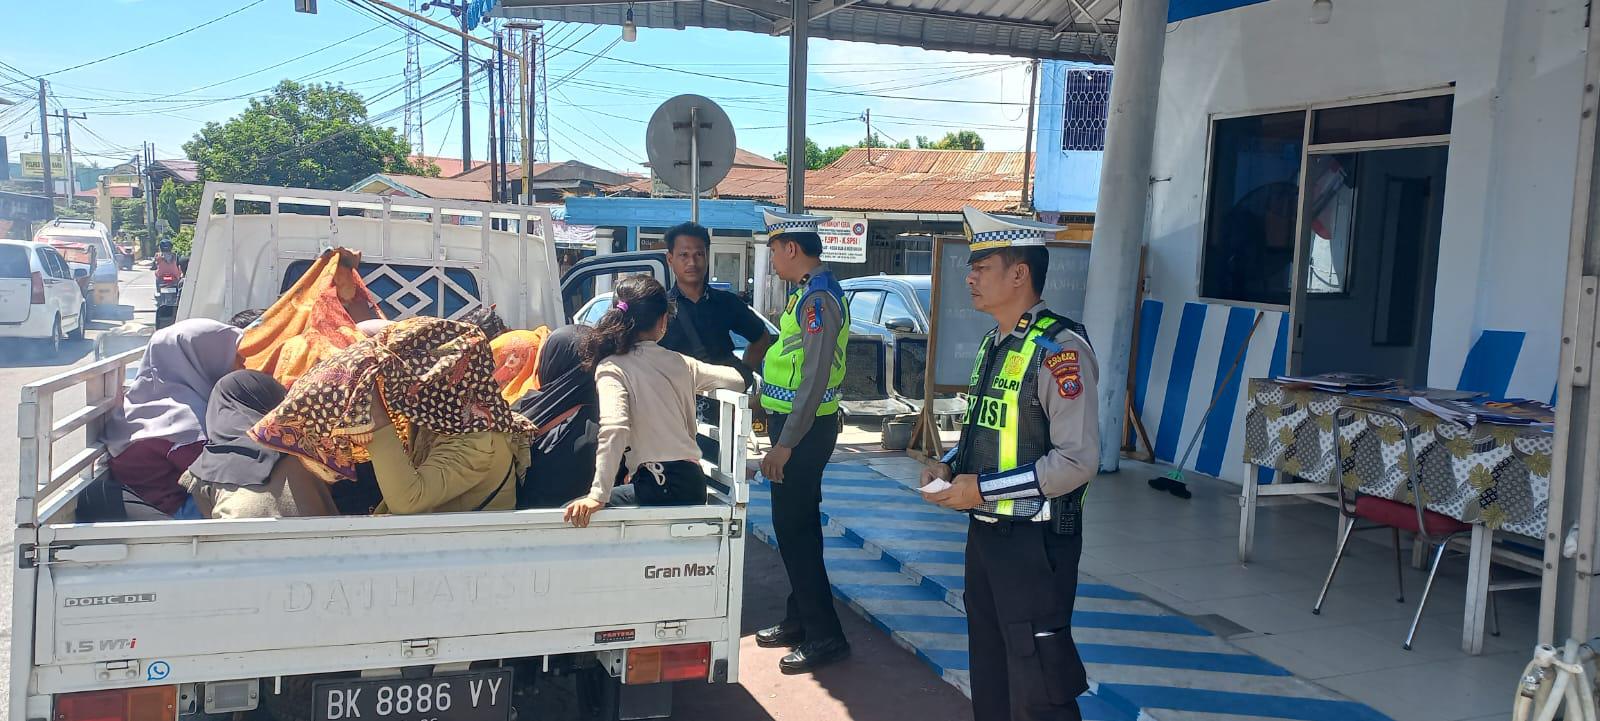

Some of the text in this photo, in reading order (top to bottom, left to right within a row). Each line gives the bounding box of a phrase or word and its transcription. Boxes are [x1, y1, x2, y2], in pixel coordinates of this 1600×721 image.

[993, 377, 1020, 392] POLRI
[644, 563, 716, 579] Gran Max
[284, 567, 551, 613] DAIHATSU
[65, 596, 120, 607] DOHC
[65, 640, 94, 654] 1.5
[327, 677, 502, 720] BK 8886 VY
